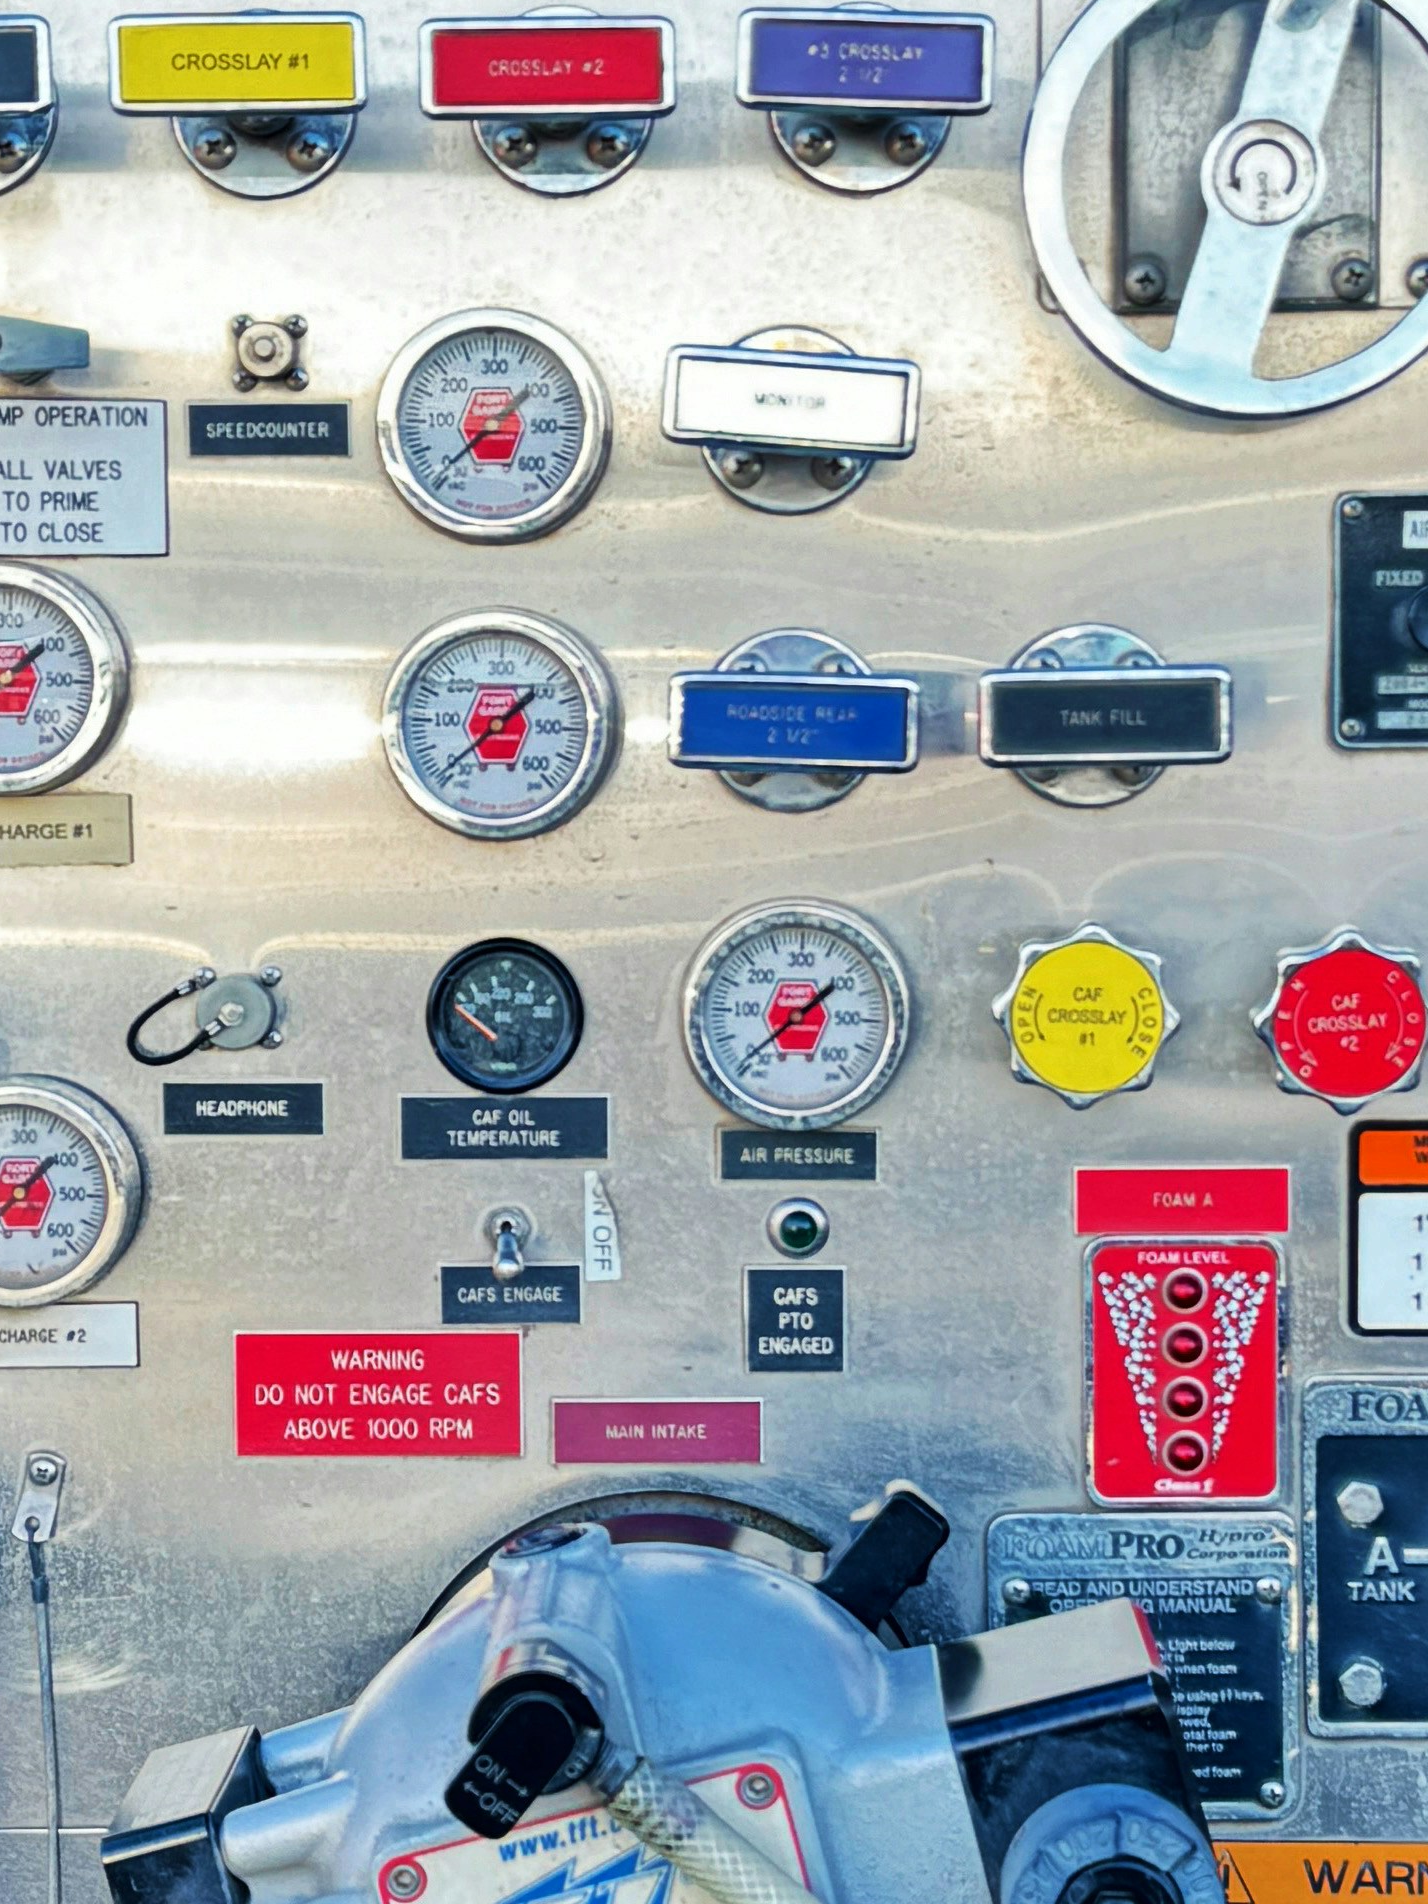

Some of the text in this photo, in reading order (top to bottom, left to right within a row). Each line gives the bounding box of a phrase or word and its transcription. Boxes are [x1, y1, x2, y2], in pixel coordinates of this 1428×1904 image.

[171, 52, 309, 70] CROSSLAY #1
[36, 406, 148, 427] OPERATION
[206, 419, 330, 439] SPEEDCOUNTER
[44, 459, 122, 480] VALVES
[4, 491, 31, 511] TO
[41, 491, 99, 511] PRIME
[0, 522, 28, 542] TO
[37, 521, 104, 542] CLOSE
[196, 1099, 289, 1117] HEADPHONE
[472, 1109, 535, 1127] CAF OIL
[447, 1130, 560, 1146] TEMPERATURE
[740, 1146, 855, 1163] AIR PRESSURE
[1413, 1253, 1423, 1271] 1
[773, 1288, 818, 1304] CAFS
[1413, 1292, 1423, 1310] 1
[778, 1313, 813, 1329] PTO
[758, 1338, 834, 1354] ENGAGED
[331, 1350, 425, 1370] WARNING
[255, 1384, 501, 1405] DO NOT ENGAGE CAFS
[284, 1418, 473, 1439] ABOVE 1000 RPM
[605, 1424, 708, 1439] MAIN INTAKE
[1367, 1538, 1398, 1573] A
[1348, 1582, 1414, 1601] TANK
